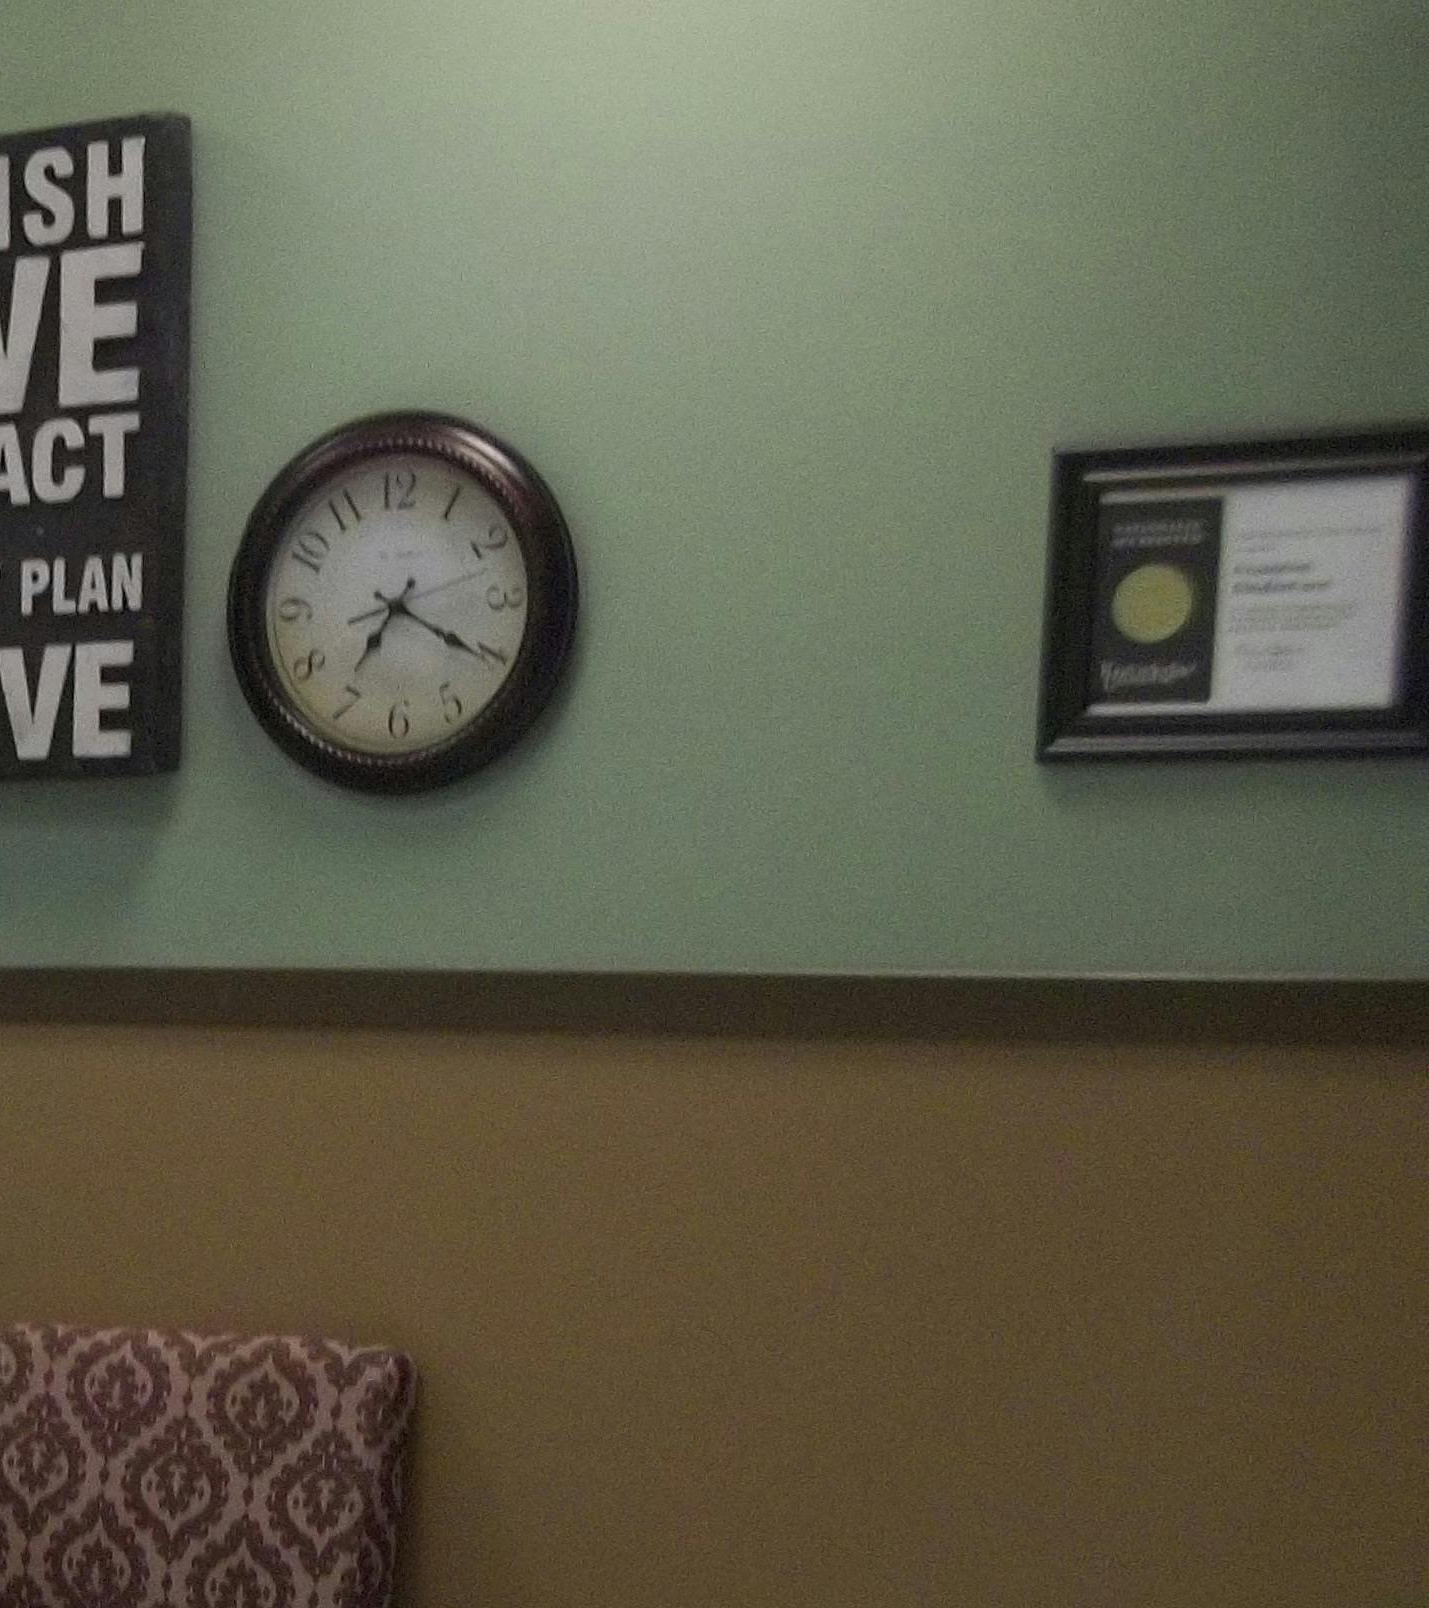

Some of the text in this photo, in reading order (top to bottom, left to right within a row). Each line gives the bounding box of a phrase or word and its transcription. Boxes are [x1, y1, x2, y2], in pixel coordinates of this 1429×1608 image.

[380, 471, 417, 511] 12
[442, 486, 461, 521] 1
[327, 489, 361, 532] 11
[291, 531, 331, 574] 10
[470, 525, 510, 560] 2
[19, 551, 144, 618] PLAN
[485, 585, 522, 611] 3
[278, 597, 314, 624] 9
[292, 647, 326, 682] 8
[332, 684, 361, 721] 7
[386, 698, 411, 740] 6
[438, 680, 464, 724] 5
